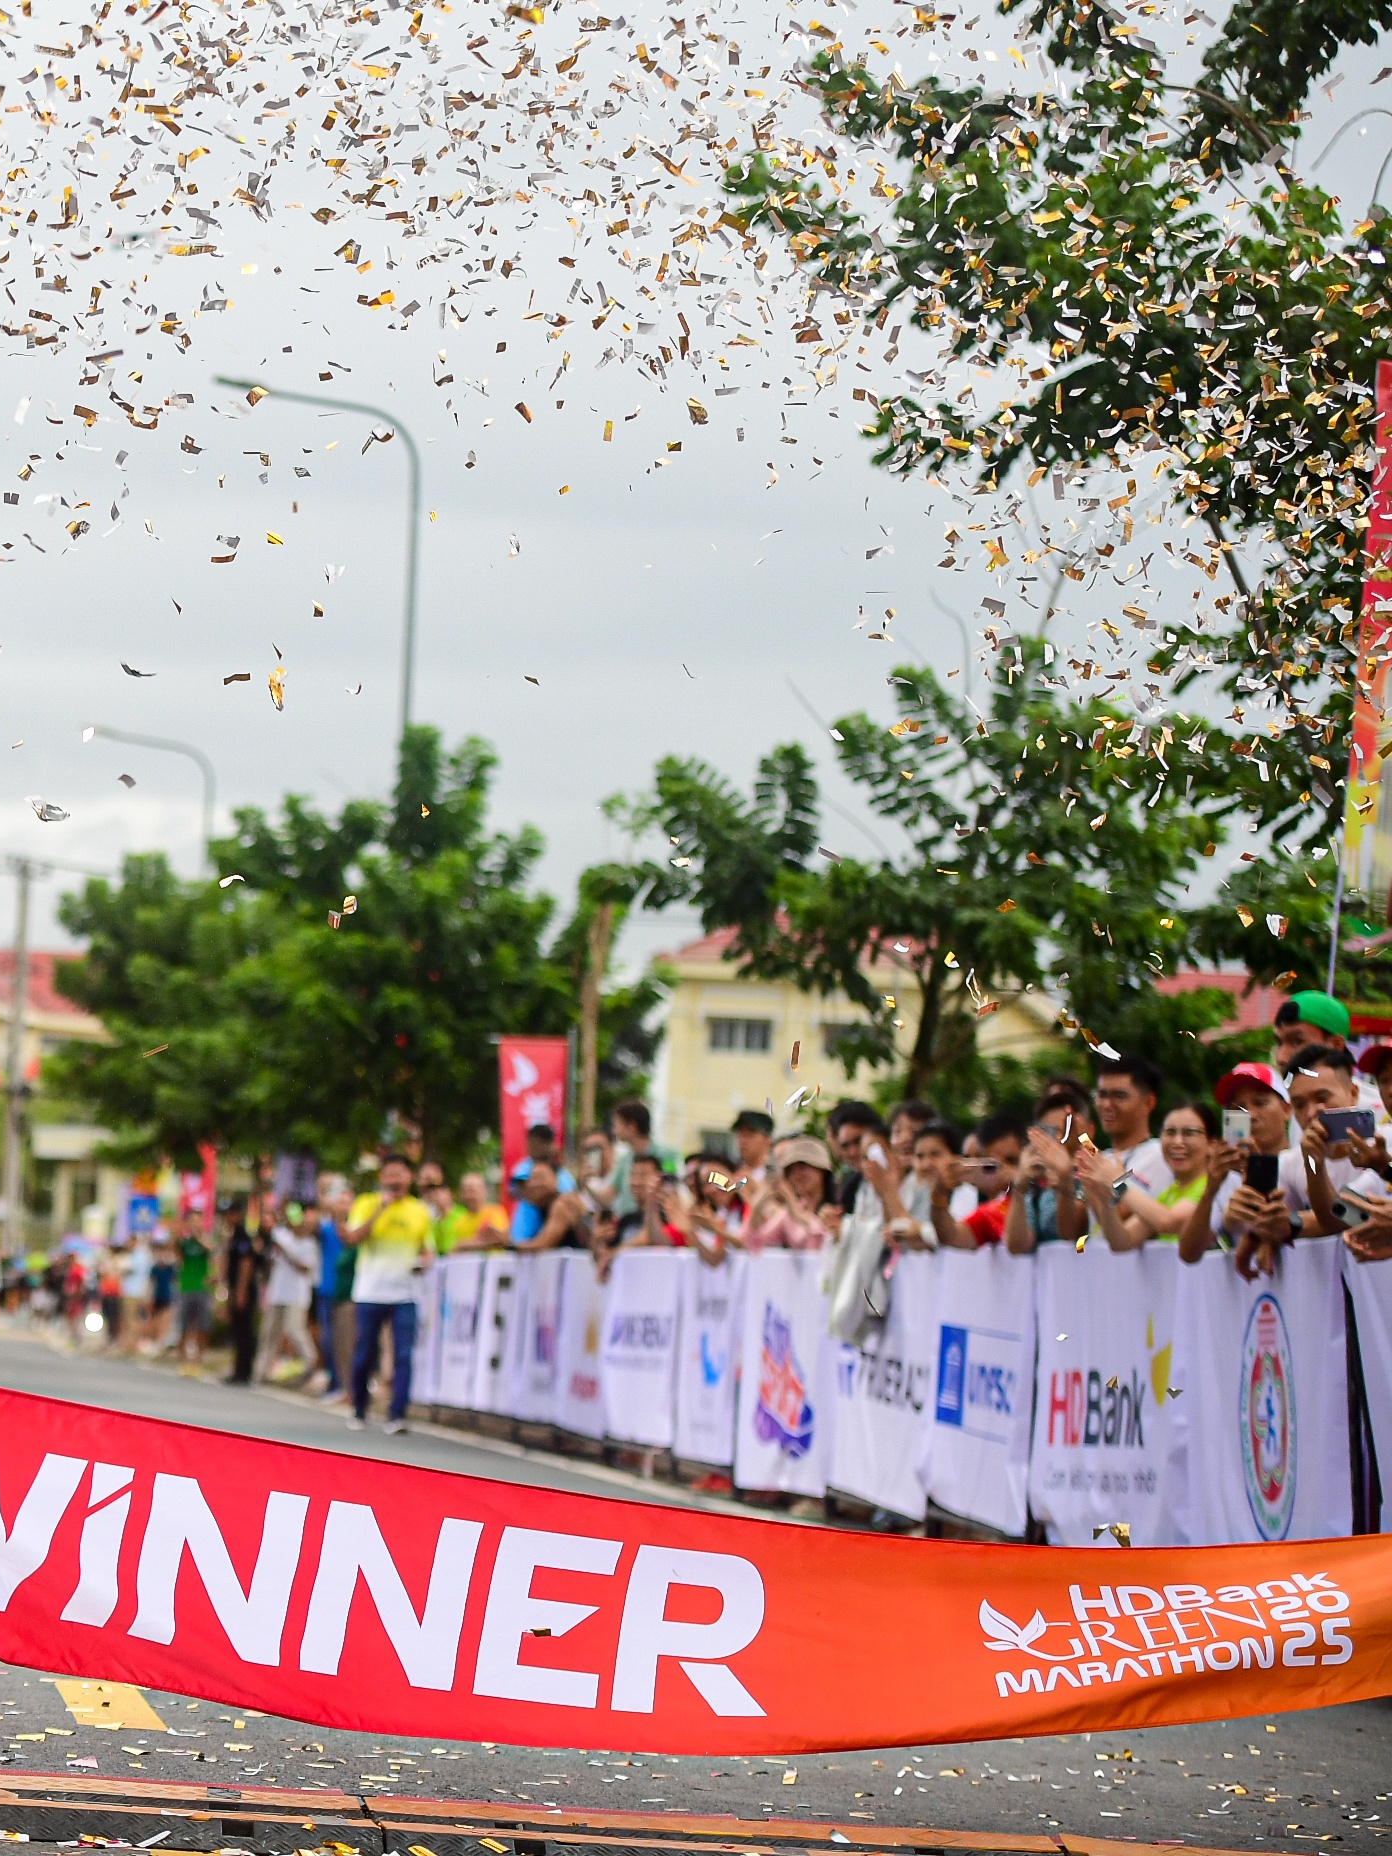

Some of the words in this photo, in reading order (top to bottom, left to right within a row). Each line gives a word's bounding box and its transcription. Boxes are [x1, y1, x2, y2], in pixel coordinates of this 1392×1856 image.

[1048, 1368, 1145, 1449] HDBank
[1016, 1600, 1267, 1661] GREEN
[1266, 1590, 1351, 1621] 20
[1068, 1572, 1339, 1622] HDBank
[995, 1636, 1275, 1698] MARATHON
[1281, 1618, 1354, 1667] 25
